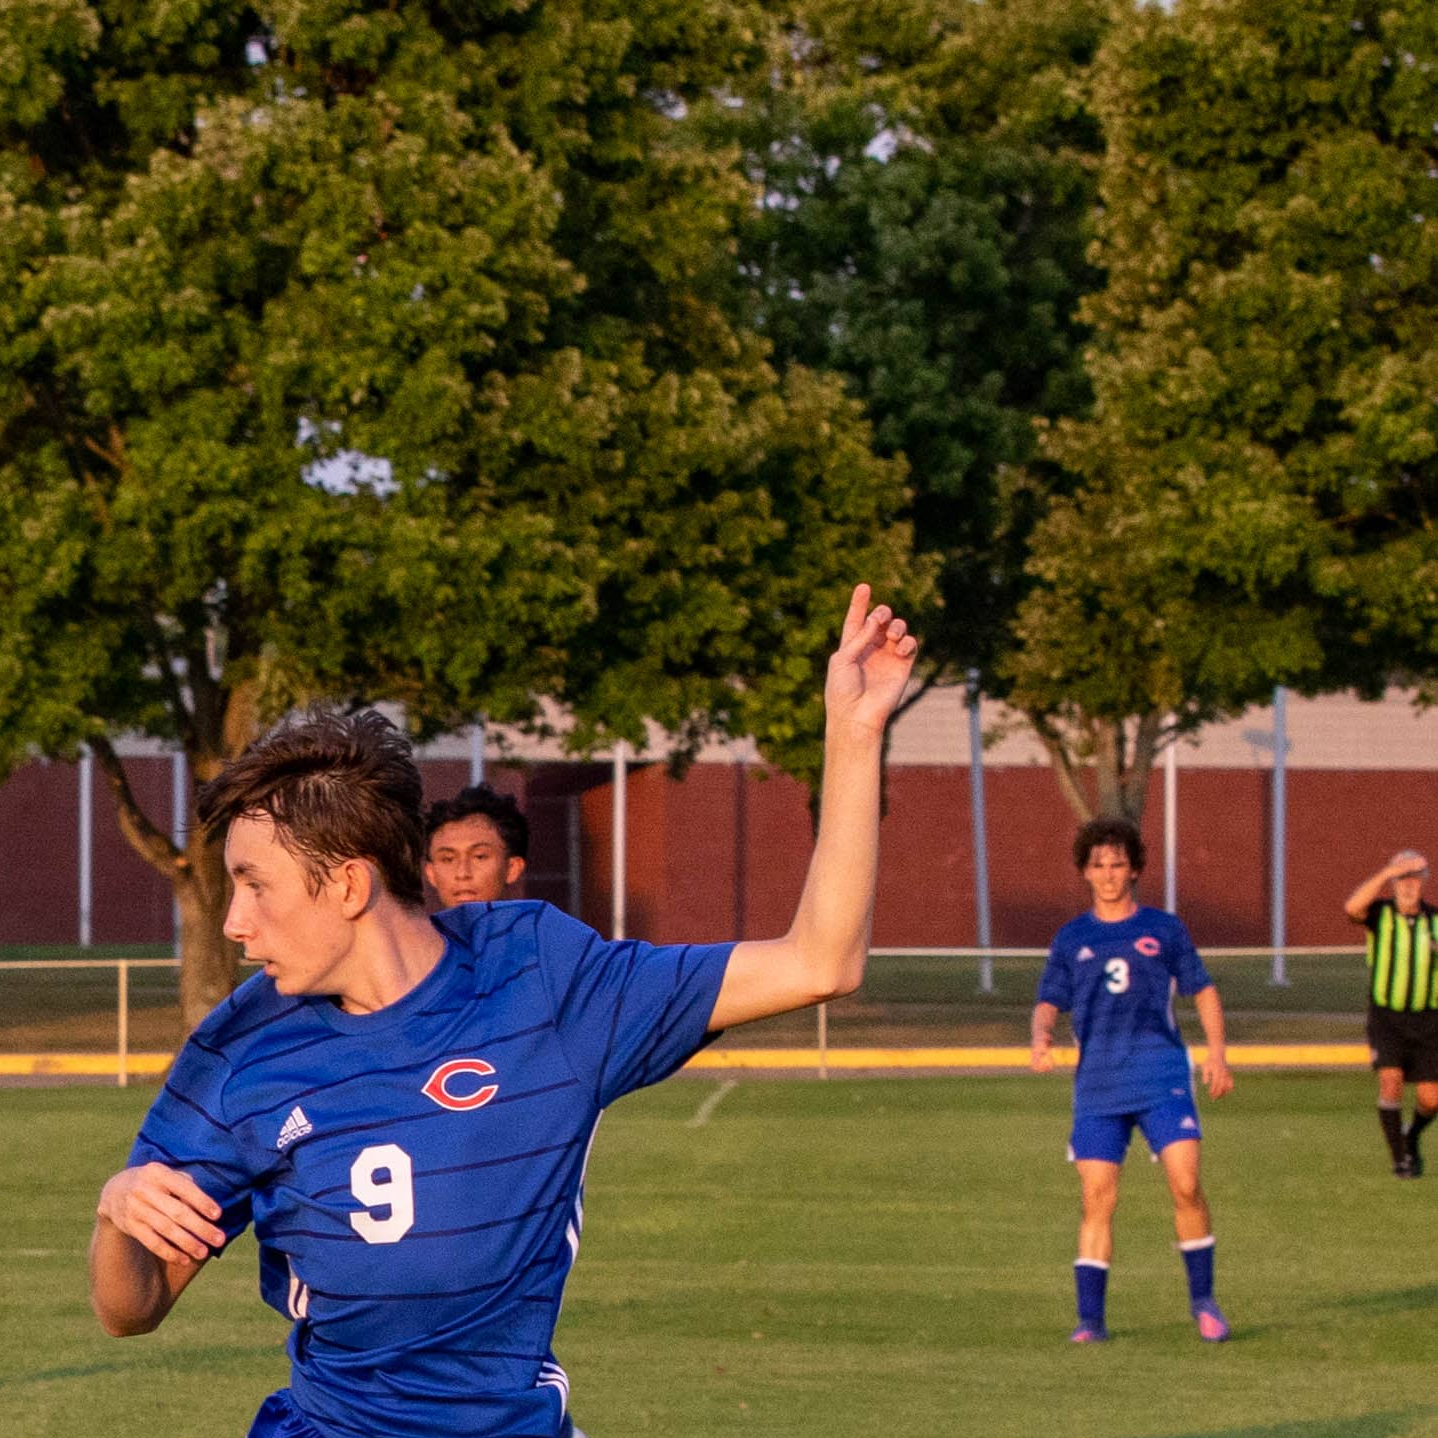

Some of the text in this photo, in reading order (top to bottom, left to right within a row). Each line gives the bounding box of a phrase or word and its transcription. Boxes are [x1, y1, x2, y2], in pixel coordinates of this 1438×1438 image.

[1105, 957, 1130, 994] 3
[421, 1058, 499, 1112] C
[276, 1123, 313, 1149] adidas
[349, 1143, 415, 1245] 9
